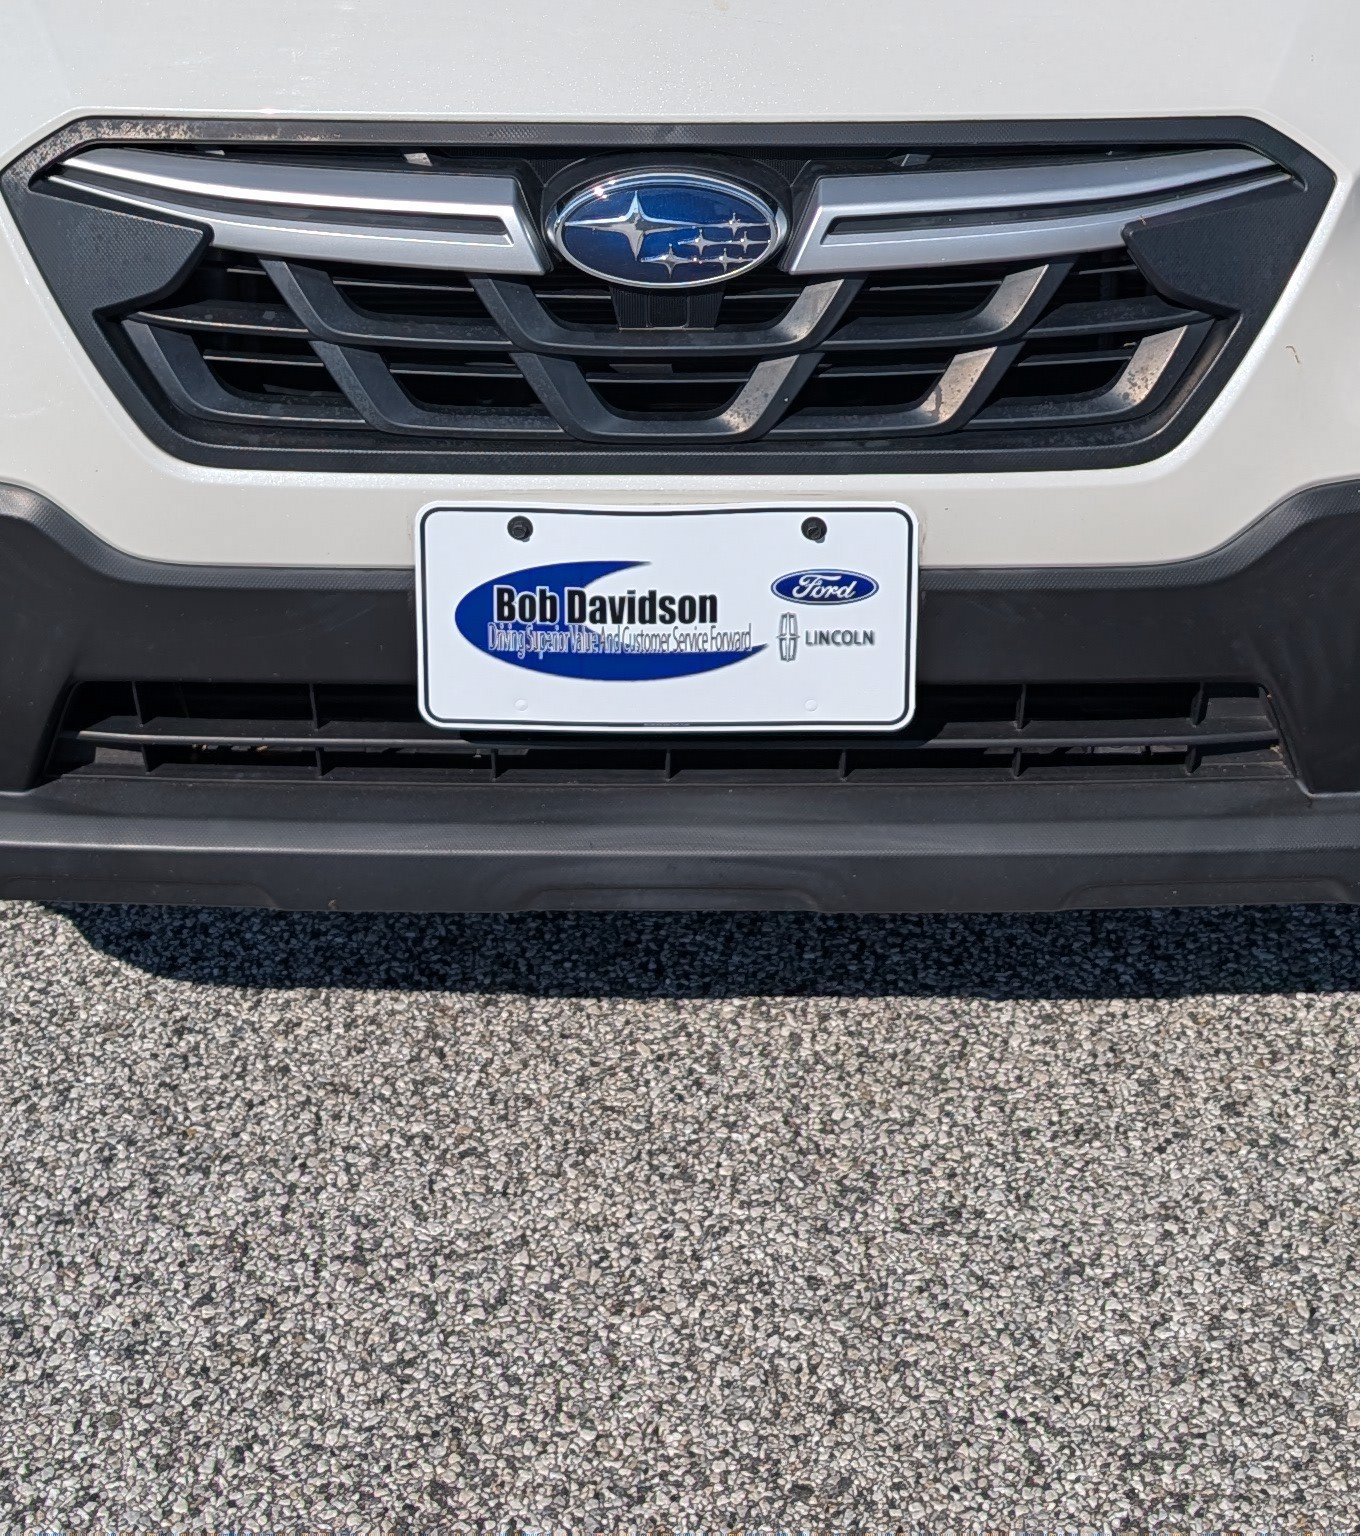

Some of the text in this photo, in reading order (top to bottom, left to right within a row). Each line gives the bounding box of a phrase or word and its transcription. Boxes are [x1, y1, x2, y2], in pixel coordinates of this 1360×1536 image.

[792, 574, 857, 598] Ford
[495, 586, 718, 625] Bob Davidson
[487, 622, 752, 659] Driving Superior Value And Customer Service Forward
[805, 630, 874, 646] LINCOLN
